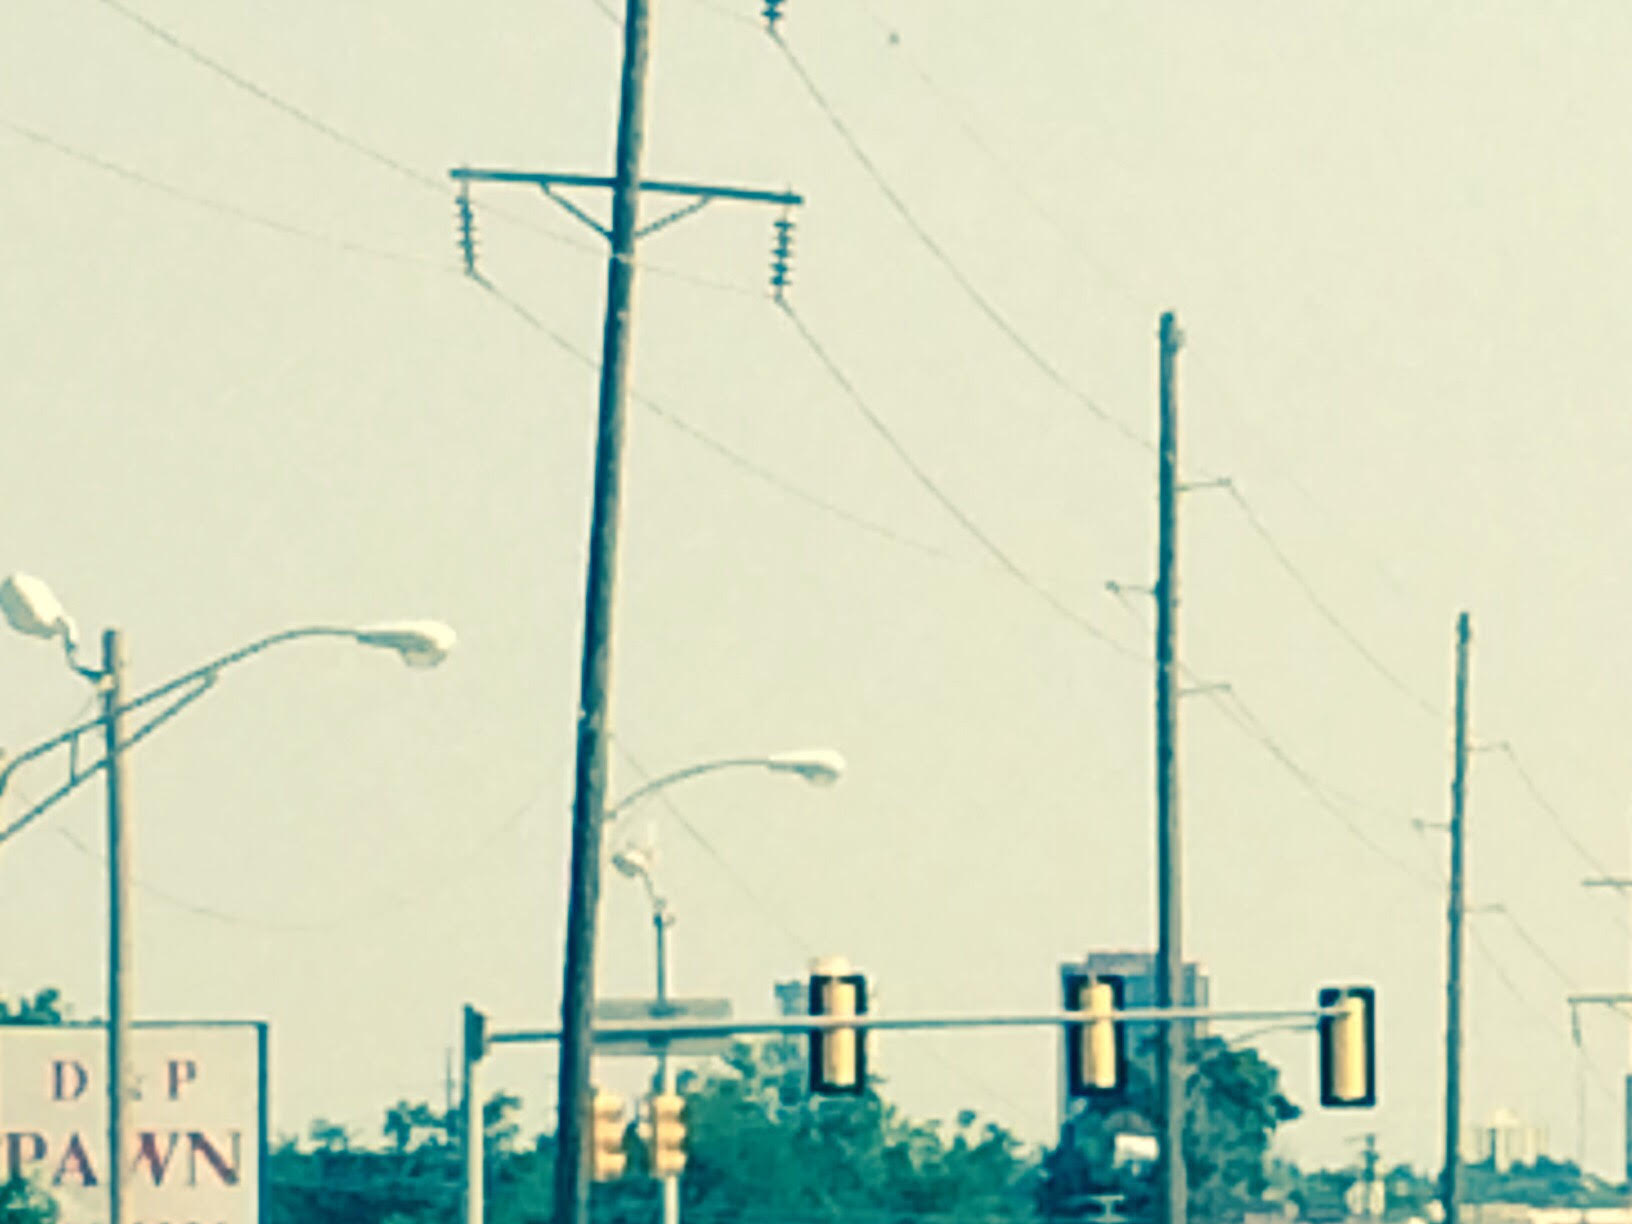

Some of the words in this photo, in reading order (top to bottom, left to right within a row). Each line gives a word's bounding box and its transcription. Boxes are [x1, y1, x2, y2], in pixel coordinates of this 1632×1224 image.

[52, 1060, 89, 1101] D
[168, 1060, 197, 1101] P
[5, 1131, 242, 1188] PAWN
